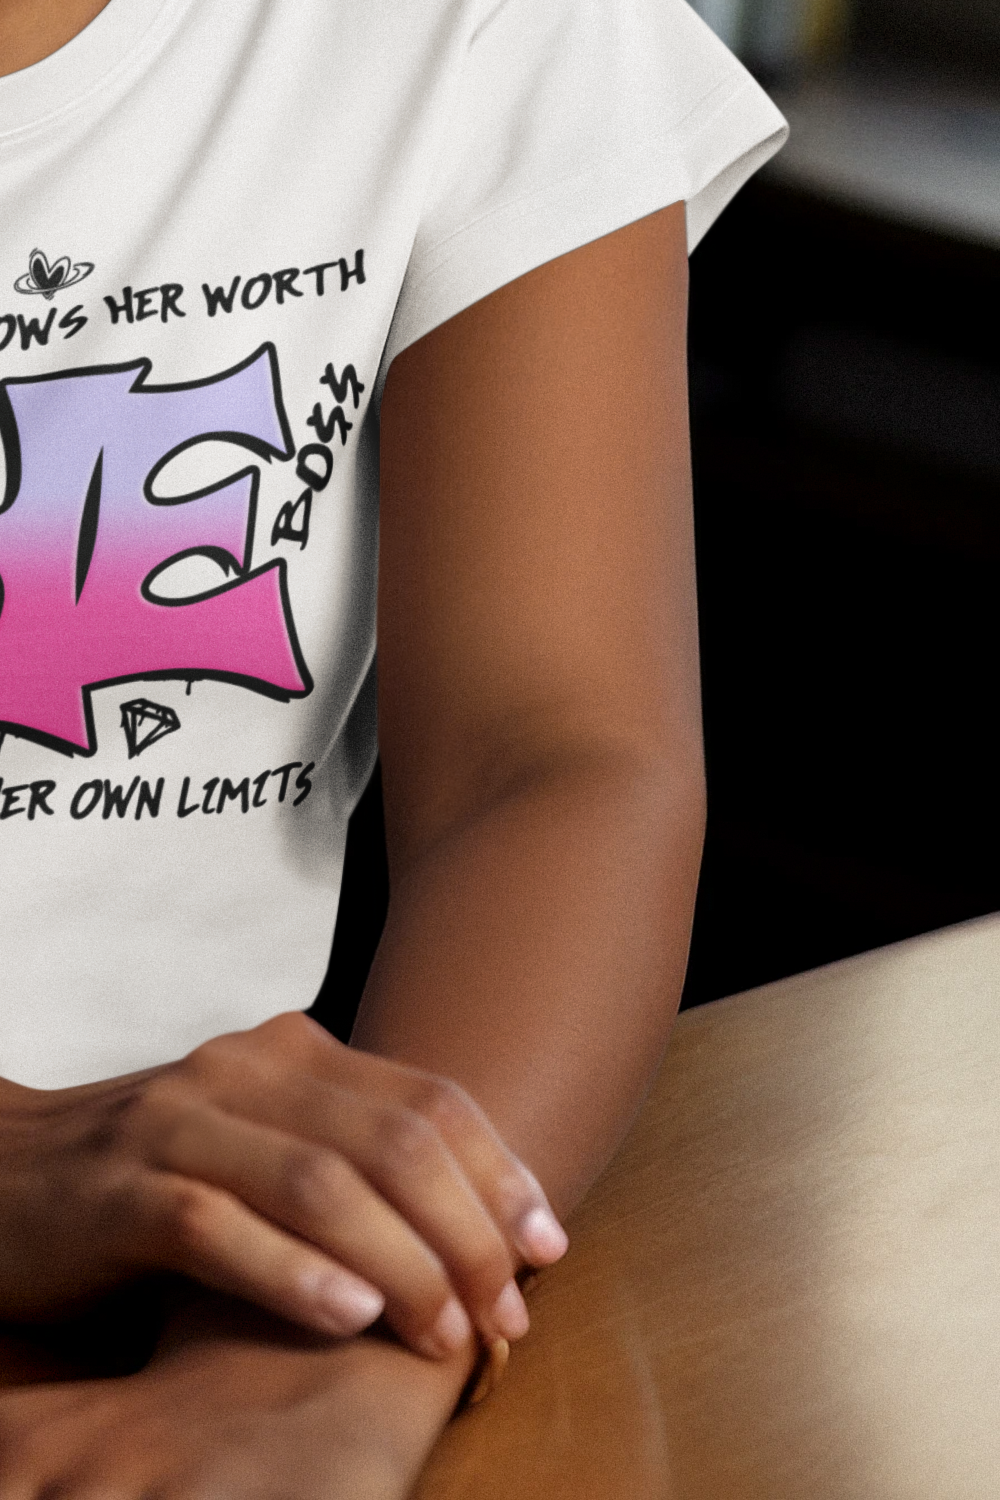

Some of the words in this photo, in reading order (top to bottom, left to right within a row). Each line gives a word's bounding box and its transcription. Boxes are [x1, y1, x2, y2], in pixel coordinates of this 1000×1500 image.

[103, 283, 187, 324] HER
[202, 249, 366, 317] WORTH
[69, 775, 165, 821] OWN
[177, 761, 316, 818] LIMITS
